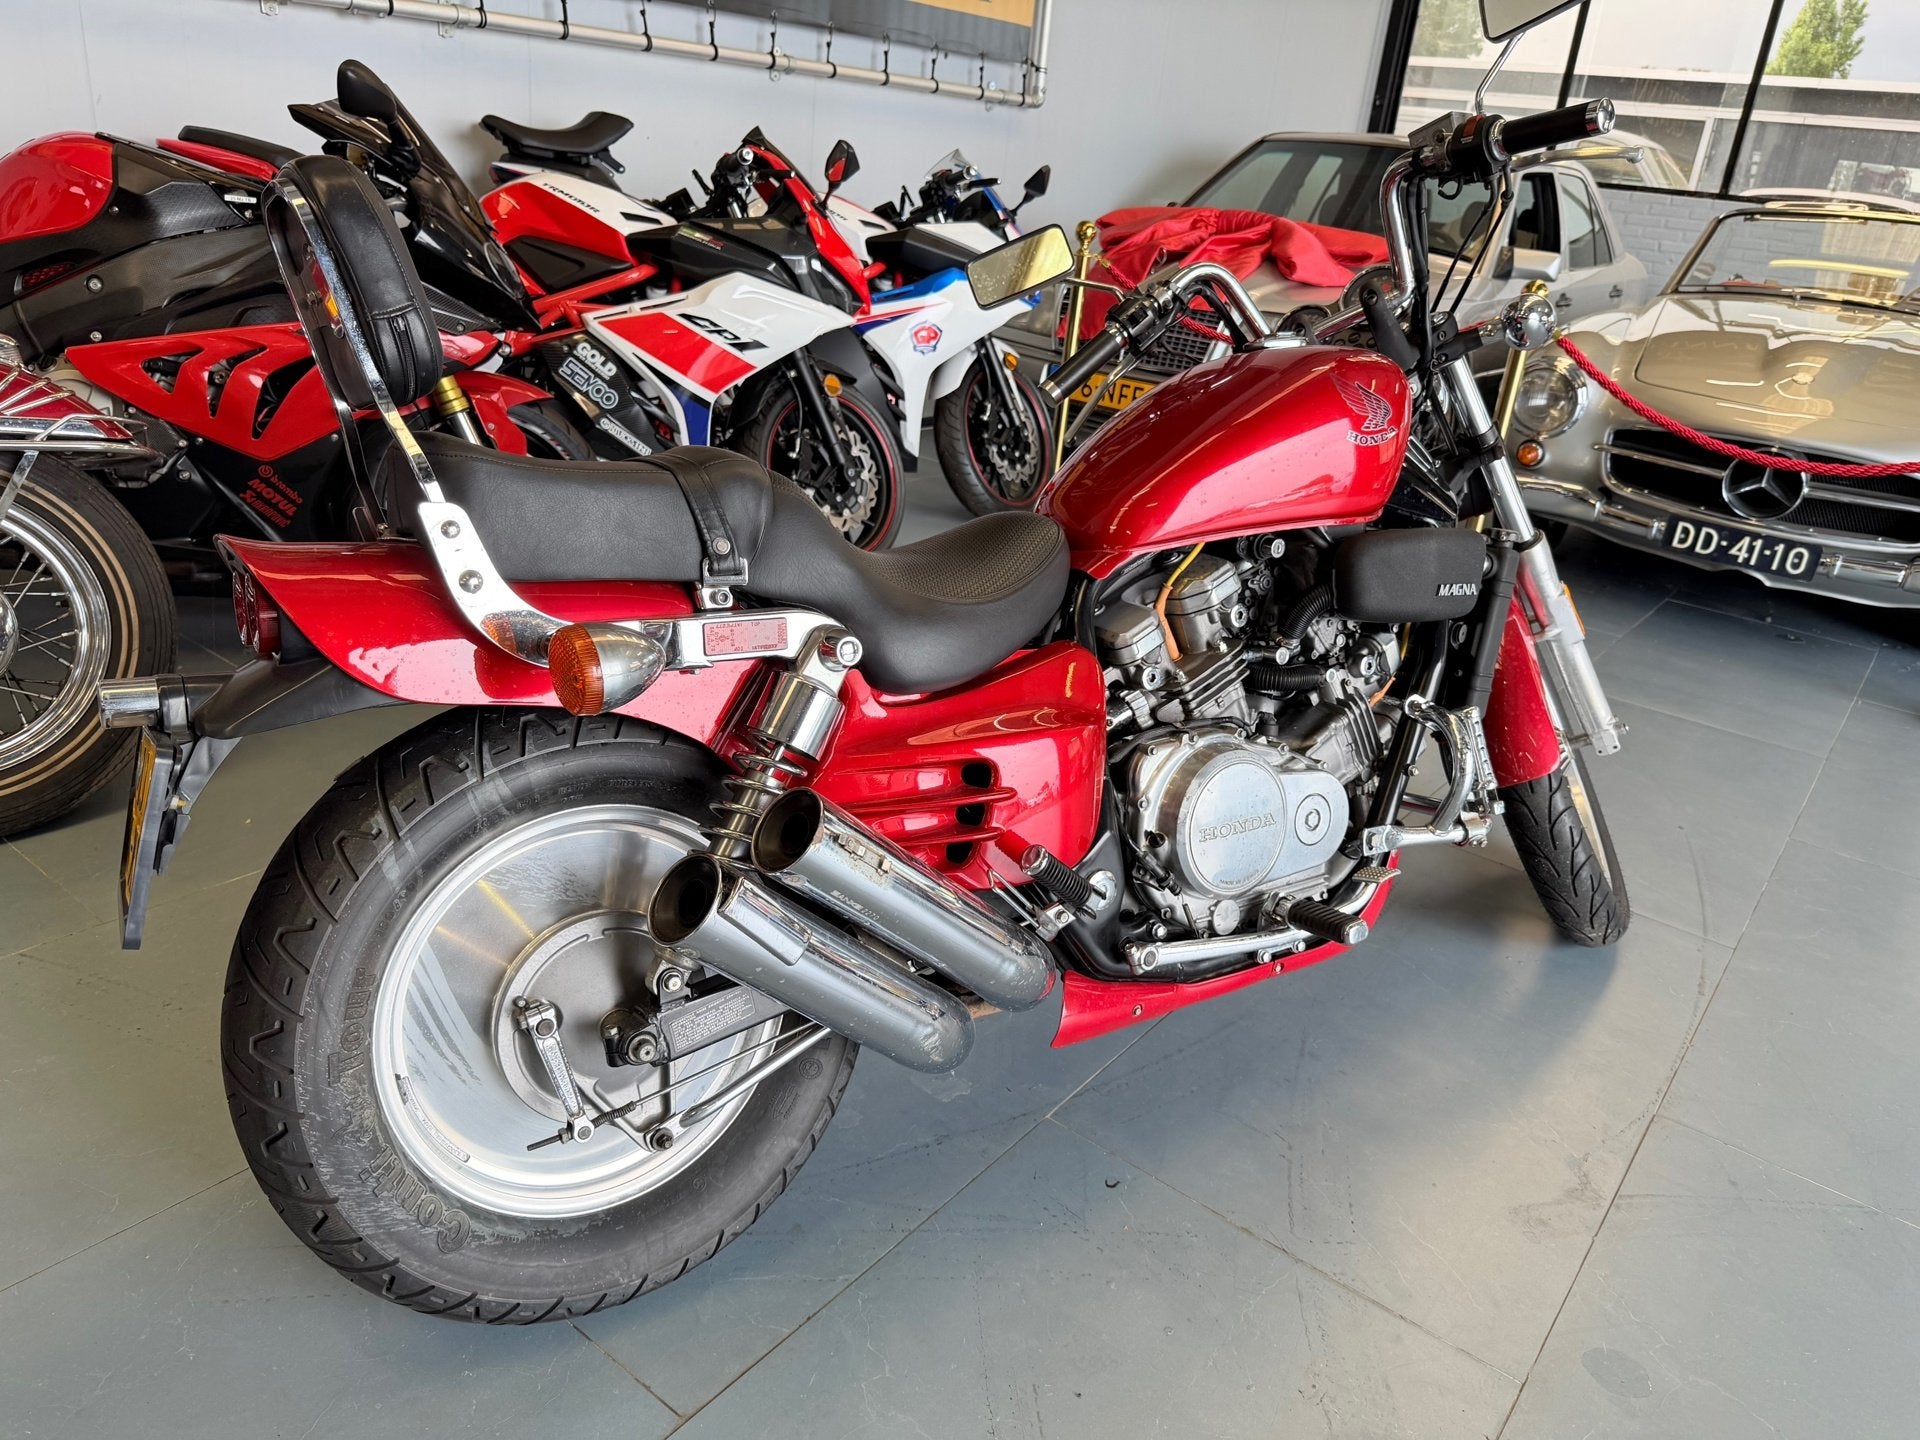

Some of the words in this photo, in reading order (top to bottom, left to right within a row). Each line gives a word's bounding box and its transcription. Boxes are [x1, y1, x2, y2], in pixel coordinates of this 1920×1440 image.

[676, 312, 770, 354] GP1
[576, 342, 617, 377] GOLD
[247, 479, 297, 516] MOTUL
[1671, 521, 1809, 575] DD-41-10
[1437, 583, 1478, 597] MAGNA
[1199, 812, 1277, 843] HONDA
[358, 1143, 472, 1254] Conti
